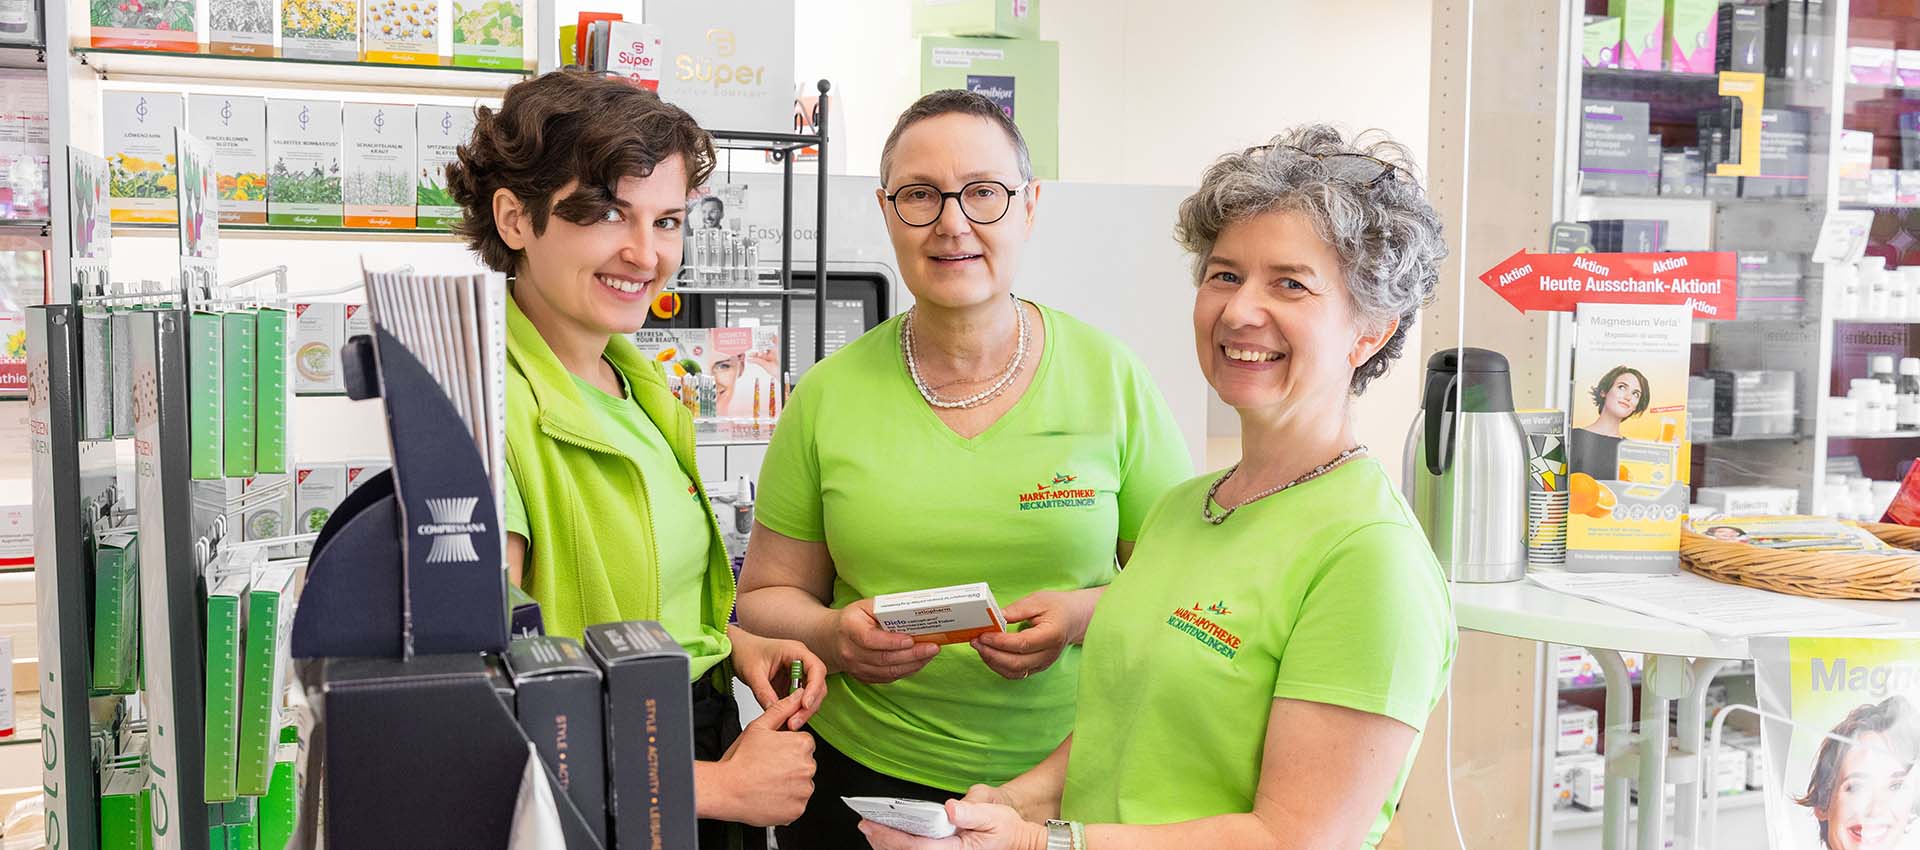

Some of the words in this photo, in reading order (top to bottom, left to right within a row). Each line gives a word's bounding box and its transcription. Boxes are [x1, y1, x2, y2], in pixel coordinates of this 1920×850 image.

[1498, 263, 1533, 287] Aktion
[1572, 256, 1610, 277] Aktion
[1652, 255, 1688, 275] Aktion
[1539, 276, 1582, 292] Heute
[1585, 276, 1721, 294] Ausschank-Aktion!
[1684, 297, 1718, 316] Aktion
[1590, 316, 1650, 328] Magnesium
[1019, 489, 1096, 502] MARKT-APOTHEKE
[1019, 498, 1096, 511] NECKARTENZLINGEN
[914, 607, 952, 616] ratiopharm
[1166, 615, 1236, 660] NECKARTENZLINGEN
[1173, 607, 1241, 649] MARKT-APOTHEKE
[646, 698, 657, 733] STYLE
[555, 715, 568, 749] STYLE
[647, 745, 660, 794] ACTIVITY
